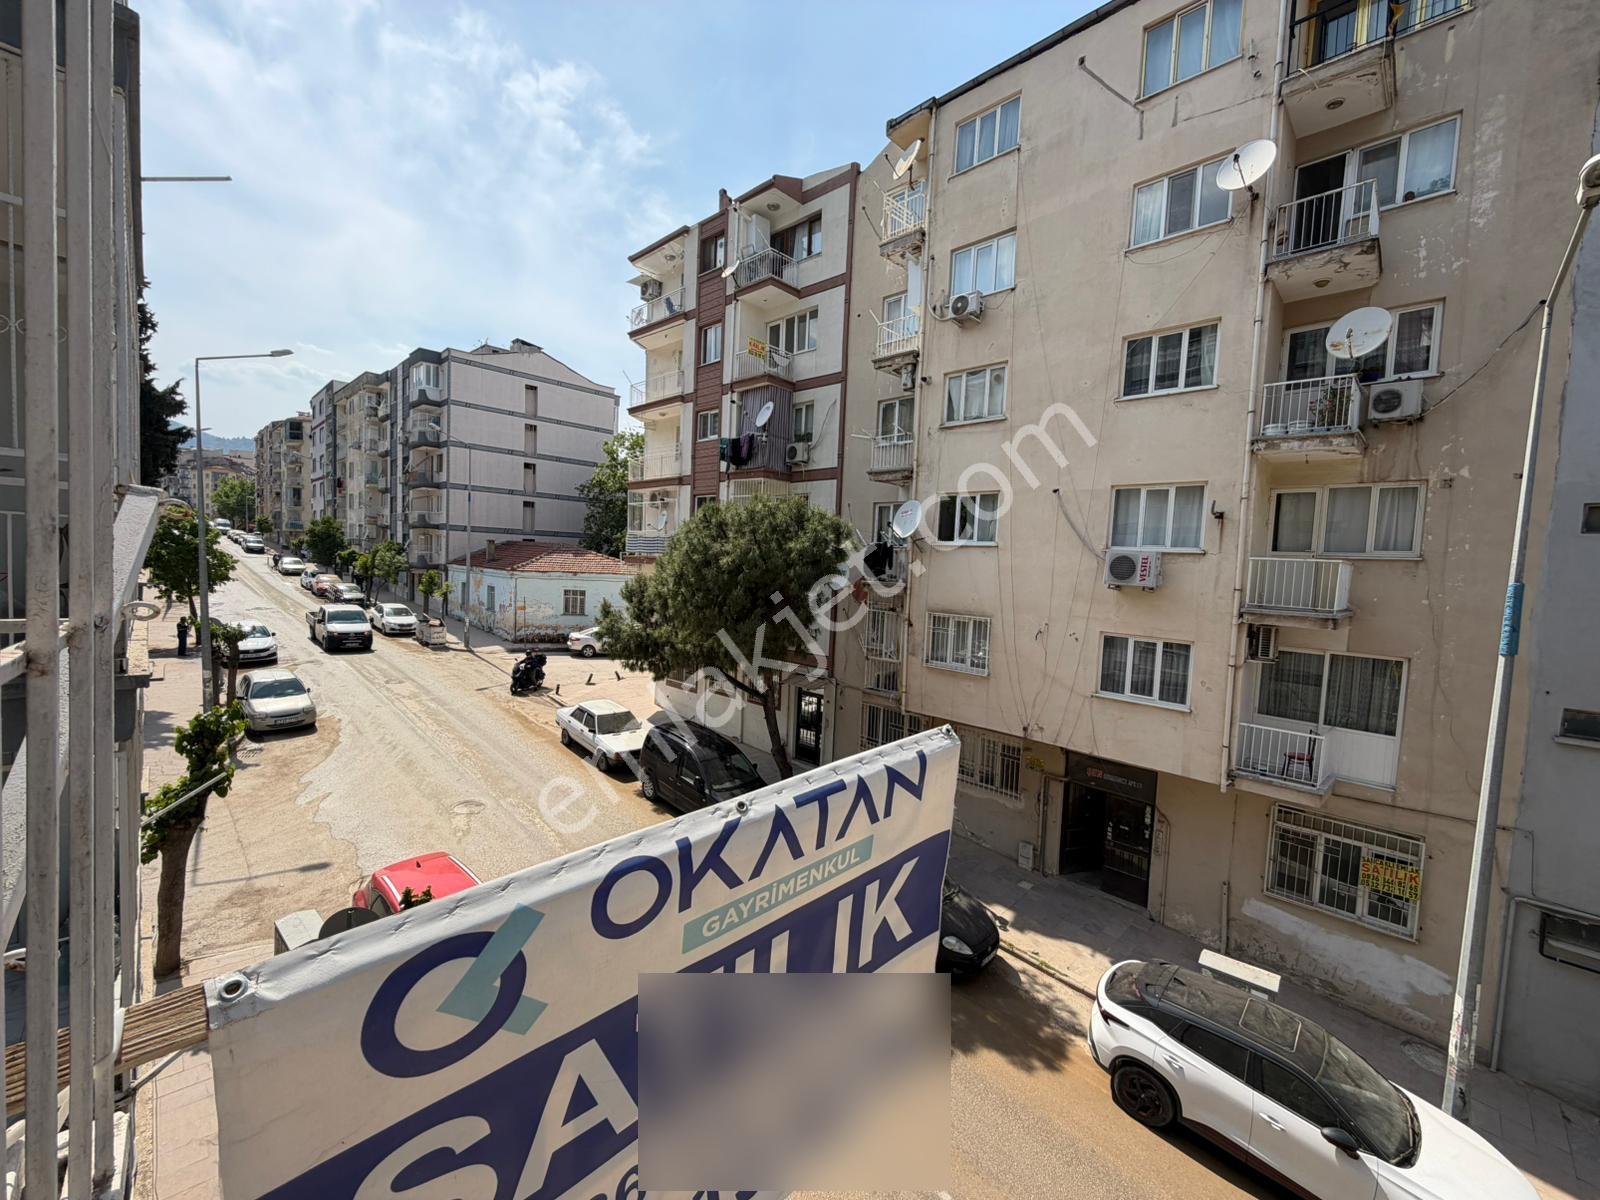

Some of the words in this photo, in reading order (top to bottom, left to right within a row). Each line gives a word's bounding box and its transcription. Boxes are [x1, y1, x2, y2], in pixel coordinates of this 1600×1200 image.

[1139, 555, 1149, 582] VESTEL
[591, 750, 928, 939] OKATAN
[1361, 862, 1419, 885] SATILIK
[702, 847, 862, 938] GAYRİMENKUL
[1408, 891, 1419, 900] 57
